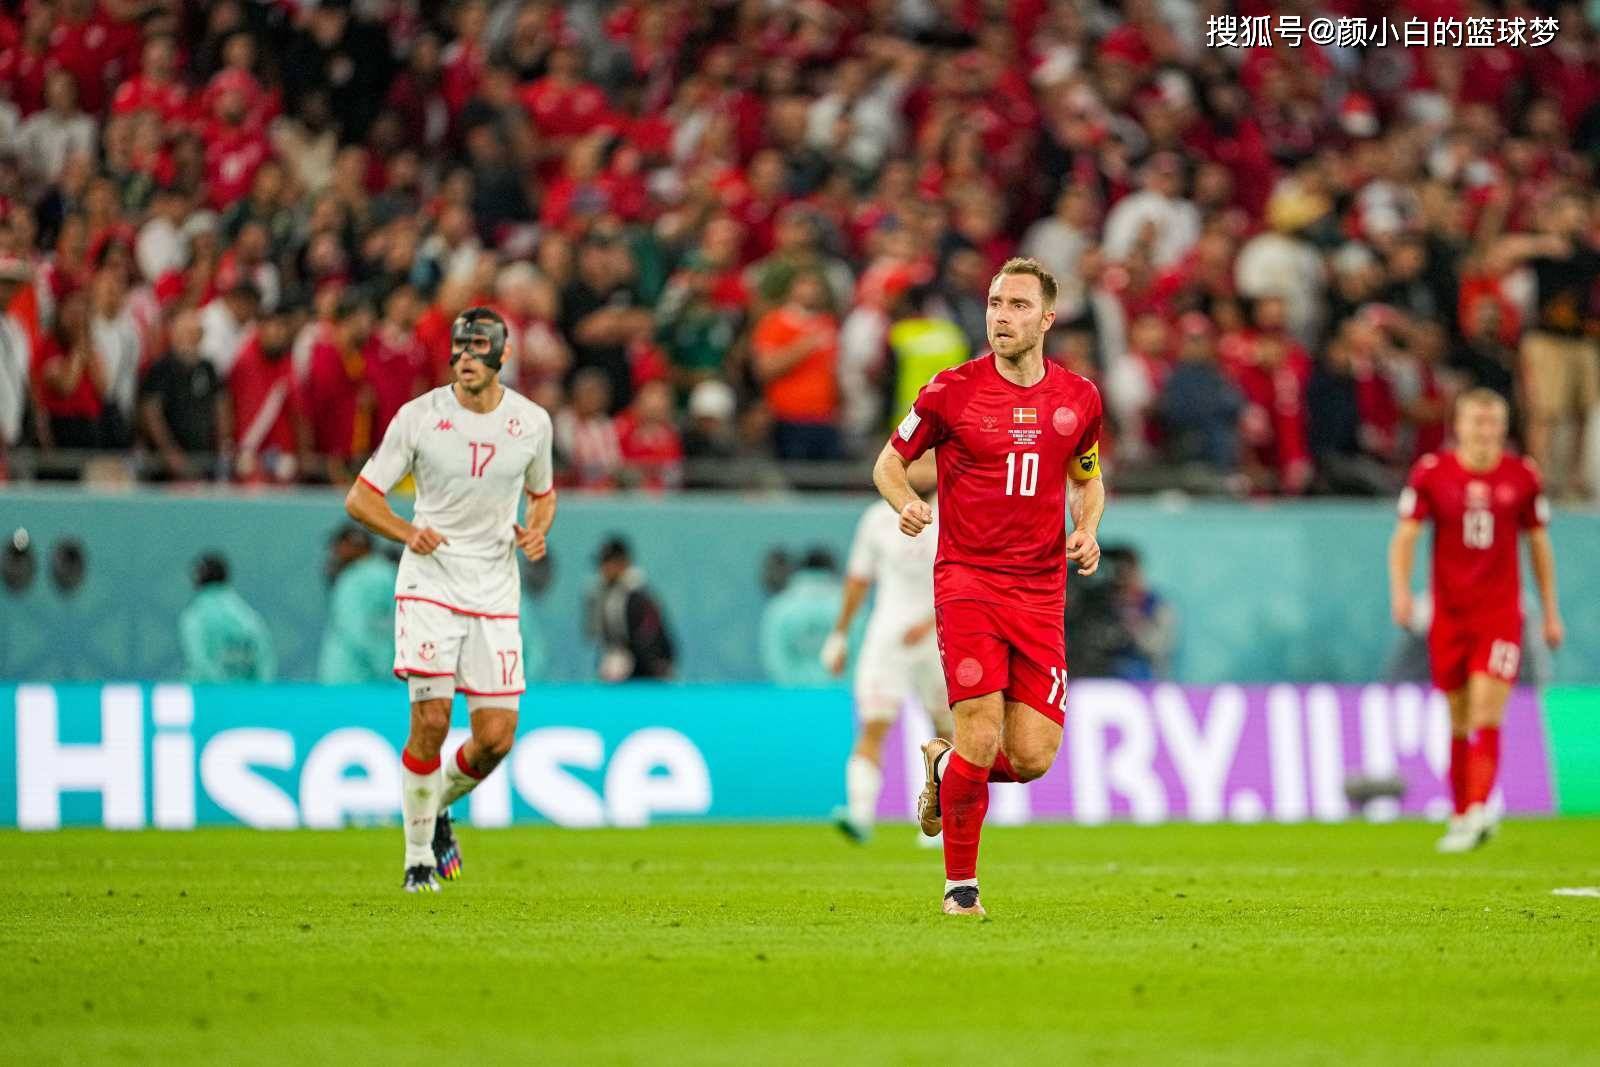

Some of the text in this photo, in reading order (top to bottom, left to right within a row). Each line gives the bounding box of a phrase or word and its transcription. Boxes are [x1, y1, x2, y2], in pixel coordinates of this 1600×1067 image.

[469, 441, 496, 479] 17
[1005, 452, 1040, 497] 10
[497, 650, 519, 685] 17
